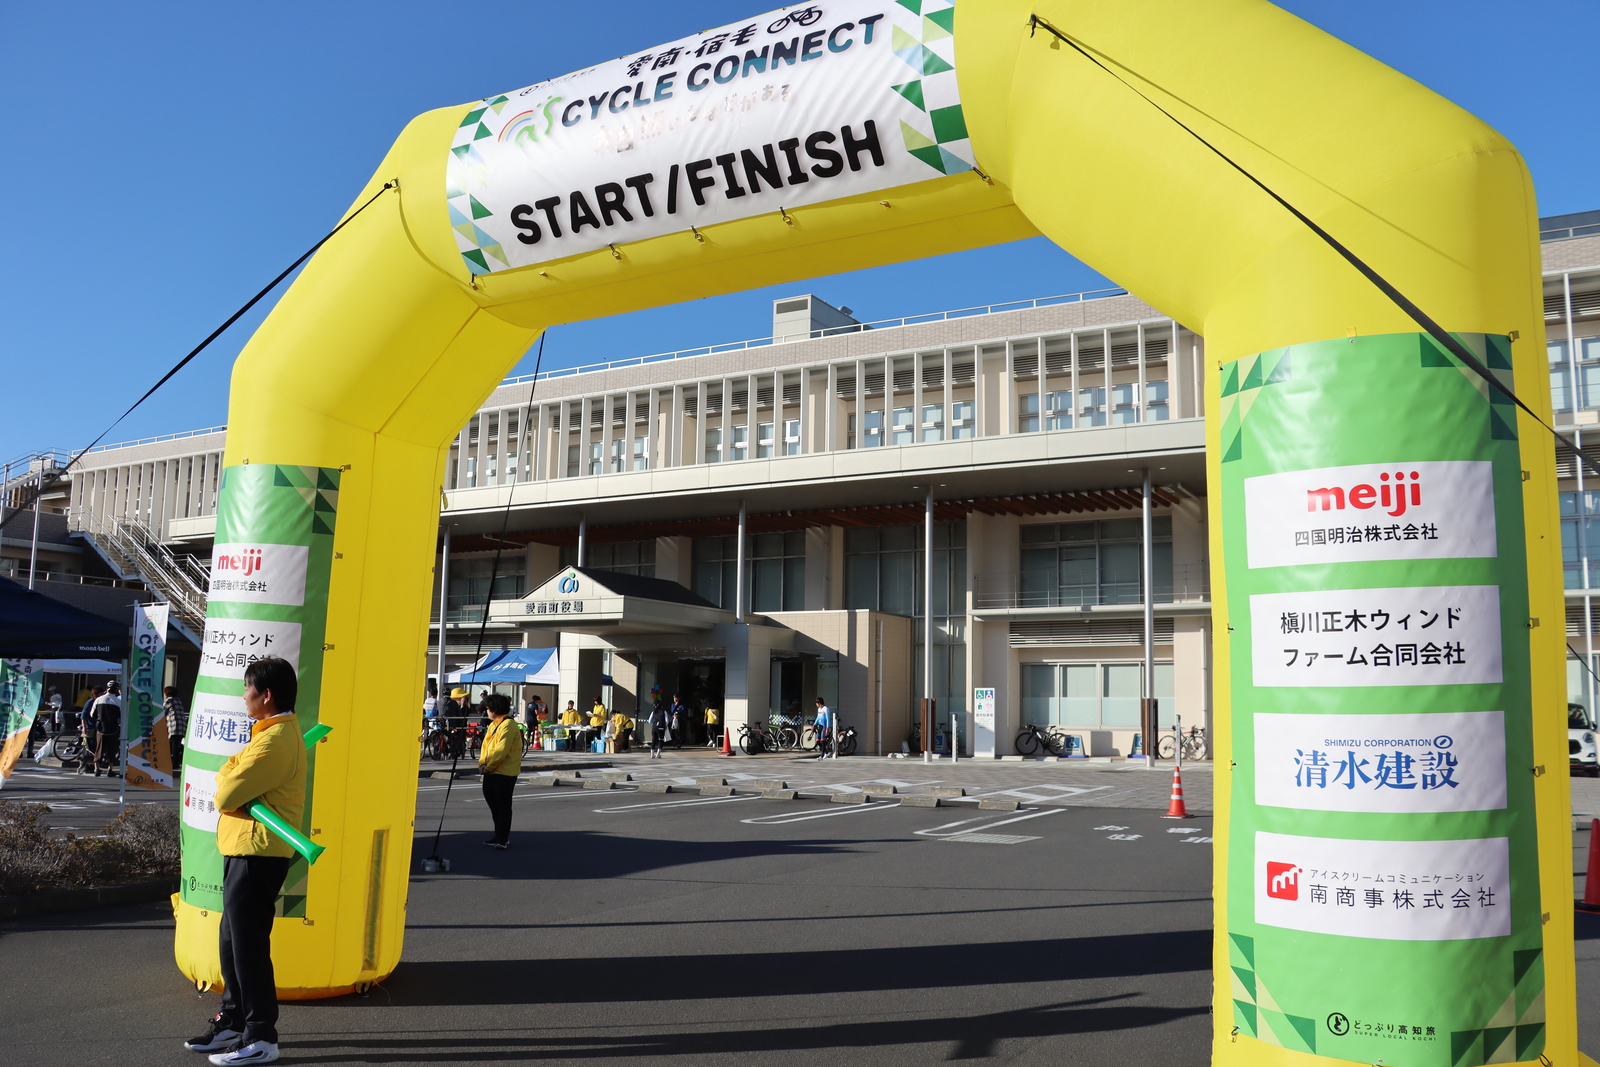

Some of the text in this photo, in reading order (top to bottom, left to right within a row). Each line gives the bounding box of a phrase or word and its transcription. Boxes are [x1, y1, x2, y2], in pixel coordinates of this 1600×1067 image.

[561, 13, 885, 128] CYCLE CONNECT
[510, 119, 885, 246] START/FINISH
[1306, 470, 1421, 517] meiji
[1294, 522, 1439, 547] 四国明治株式会社
[217, 548, 262, 577] meiji
[525, 600, 584, 614] 愛南町役場
[137, 633, 152, 687] CYCLE
[201, 652, 271, 668] ファーム合同会
[1283, 641, 1466, 667] ファーム合同会社
[1324, 738, 1432, 748] SHIMIZU CORPORATION
[1293, 748, 1460, 791] 清水建設
[1309, 868, 1485, 884] アイスクリームコミュニケーション
[1309, 883, 1496, 910] 南商事株式会社
[1353, 1019, 1436, 1036] どっぷり高知旅
